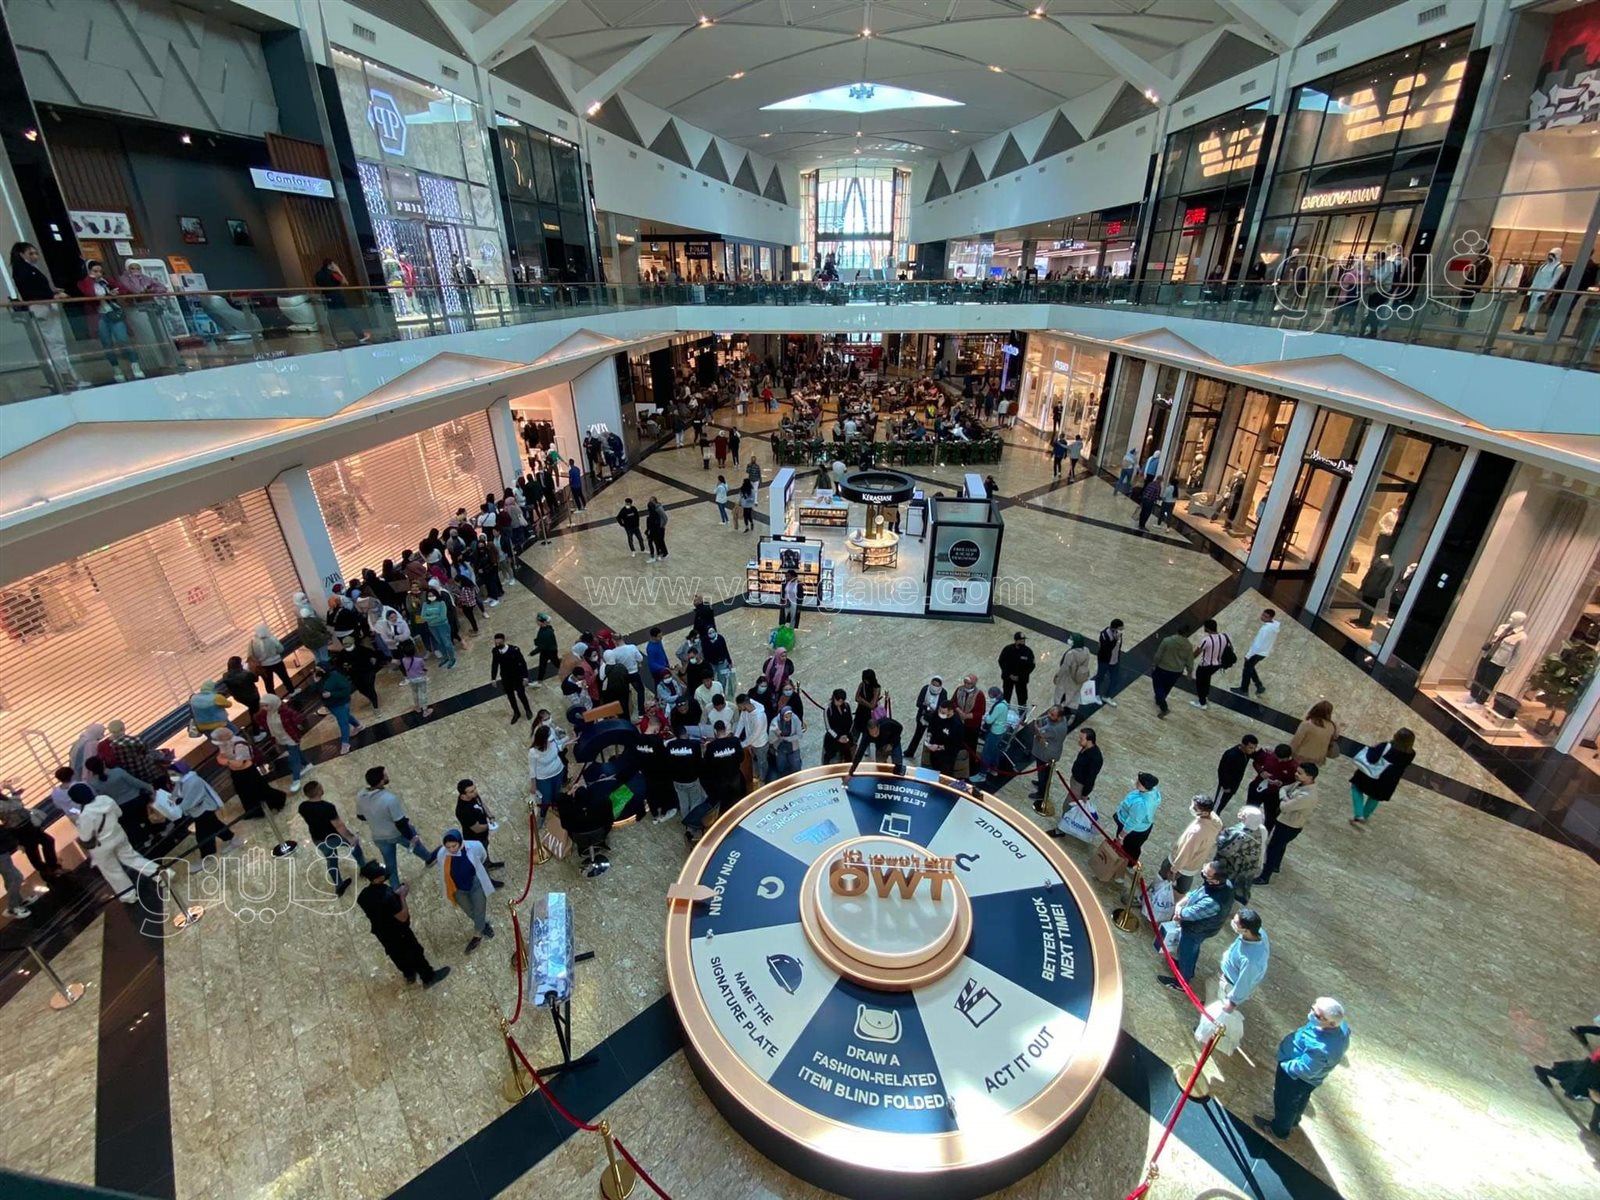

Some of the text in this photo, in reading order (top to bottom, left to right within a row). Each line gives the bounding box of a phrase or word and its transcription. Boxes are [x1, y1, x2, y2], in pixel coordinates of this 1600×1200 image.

[266, 171, 312, 187] Comfort
[874, 792, 927, 808] LETS MAKE
[876, 783, 928, 799] MEMORIES
[974, 817, 1027, 860] POP QUIZ
[708, 850, 741, 916] SPIN AGAIN
[1032, 897, 1056, 982] BETTER LUCK
[1050, 904, 1075, 980] NEXT TIME!
[710, 956, 779, 1058] SIGNATURE PLATE
[734, 971, 774, 1026] NAME THE
[812, 1051, 937, 1087] FASHION-RELATED
[846, 1045, 900, 1066] DRAW A
[984, 1025, 1054, 1093] ACT IT OUT
[798, 1066, 945, 1110] ITEM BLIND FOLDED
